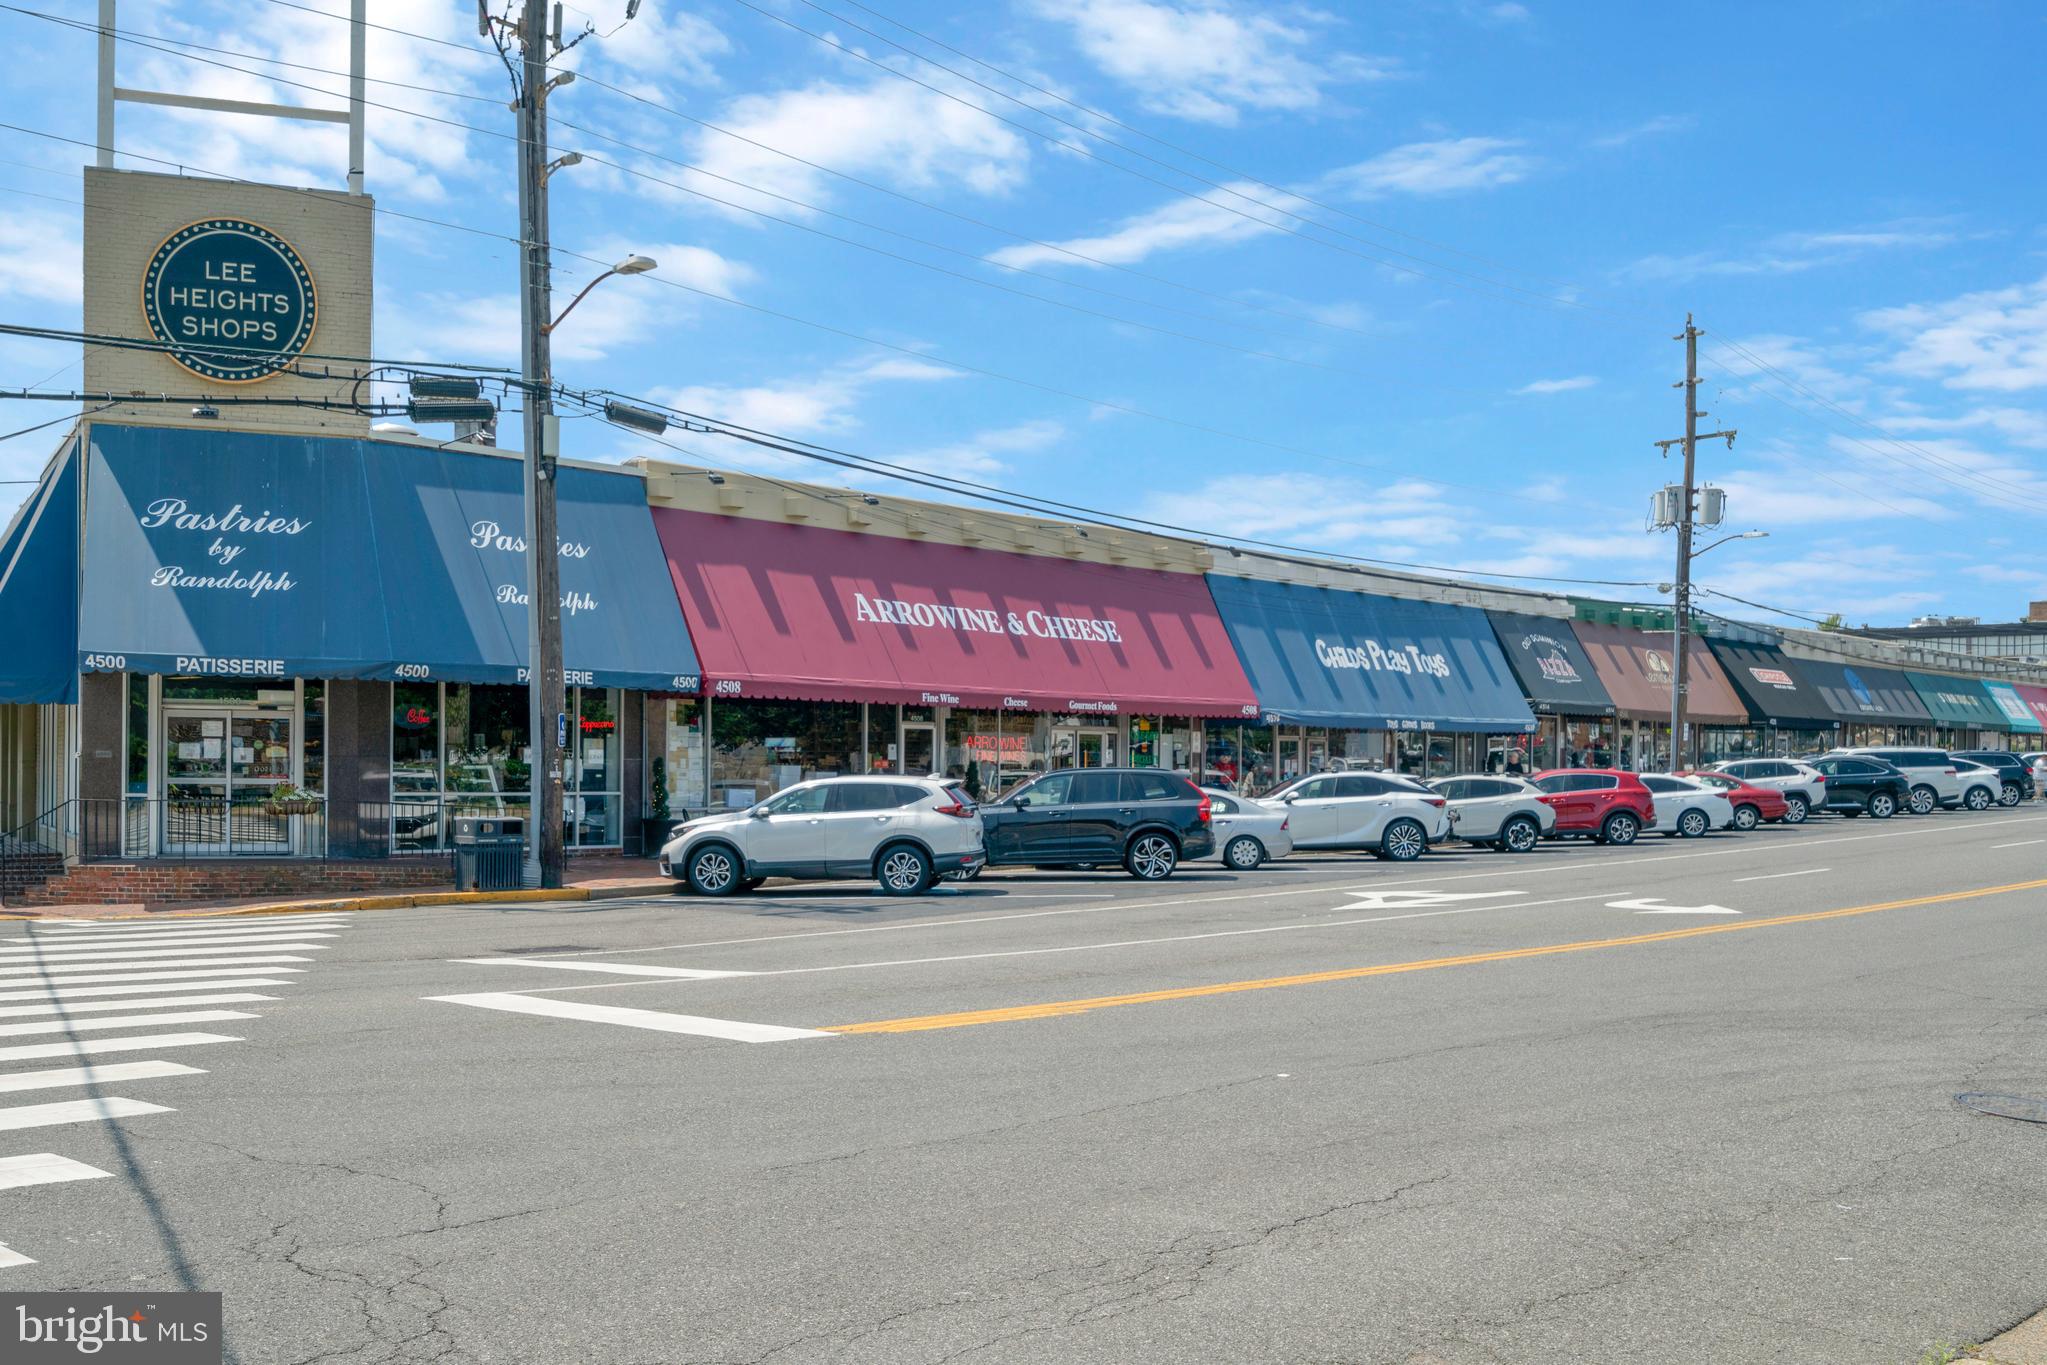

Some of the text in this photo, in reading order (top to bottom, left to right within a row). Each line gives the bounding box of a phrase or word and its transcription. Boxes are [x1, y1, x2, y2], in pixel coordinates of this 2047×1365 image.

[205, 260, 257, 283] LEE
[170, 286, 289, 314] HEIGHTS
[182, 316, 278, 341] SHOPS
[140, 498, 312, 535] Pastries
[208, 537, 246, 566] by
[150, 565, 298, 599] Randolph
[853, 592, 1122, 643] ARROWINE & CHEESE
[85, 654, 126, 669] 4500
[176, 656, 286, 676] PATISSERIE
[395, 664, 430, 679] 4500
[517, 667, 594, 686] PAERIE
[672, 676, 699, 690] 4500
[715, 680, 742, 695] 4508
[922, 692, 960, 705] Fine Wine
[1003, 697, 1029, 708] Cheese
[1068, 700, 1118, 712] Gourmet Foods
[1241, 704, 1258, 716] 4508
[966, 735, 1026, 751] ARROWINE
